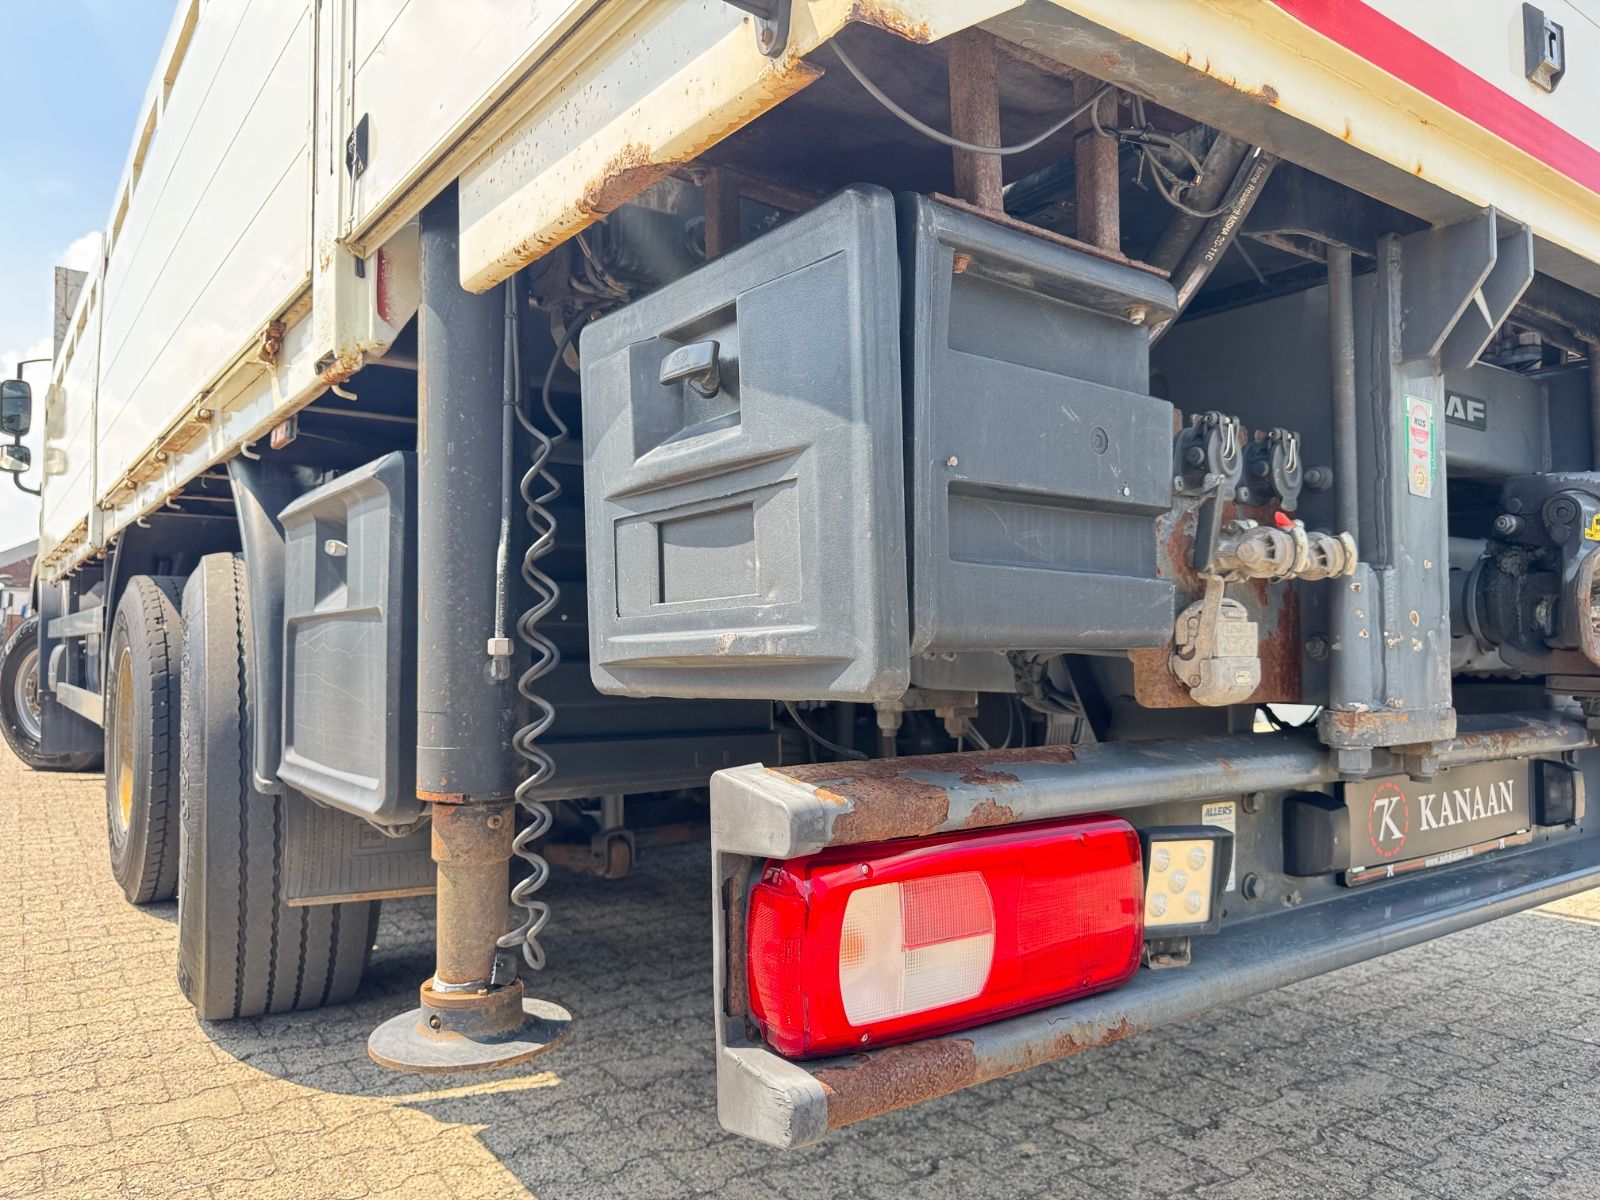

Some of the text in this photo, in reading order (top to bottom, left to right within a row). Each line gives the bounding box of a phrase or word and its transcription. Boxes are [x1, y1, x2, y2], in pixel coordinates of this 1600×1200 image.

[1249, 162, 1267, 184] Flame
[1232, 183, 1255, 215] Resistant
[1219, 213, 1238, 236] MSHA
[1445, 395, 1485, 422] AF
[1205, 806, 1232, 817] ALLERS
[1418, 780, 1514, 831] KANAAN
